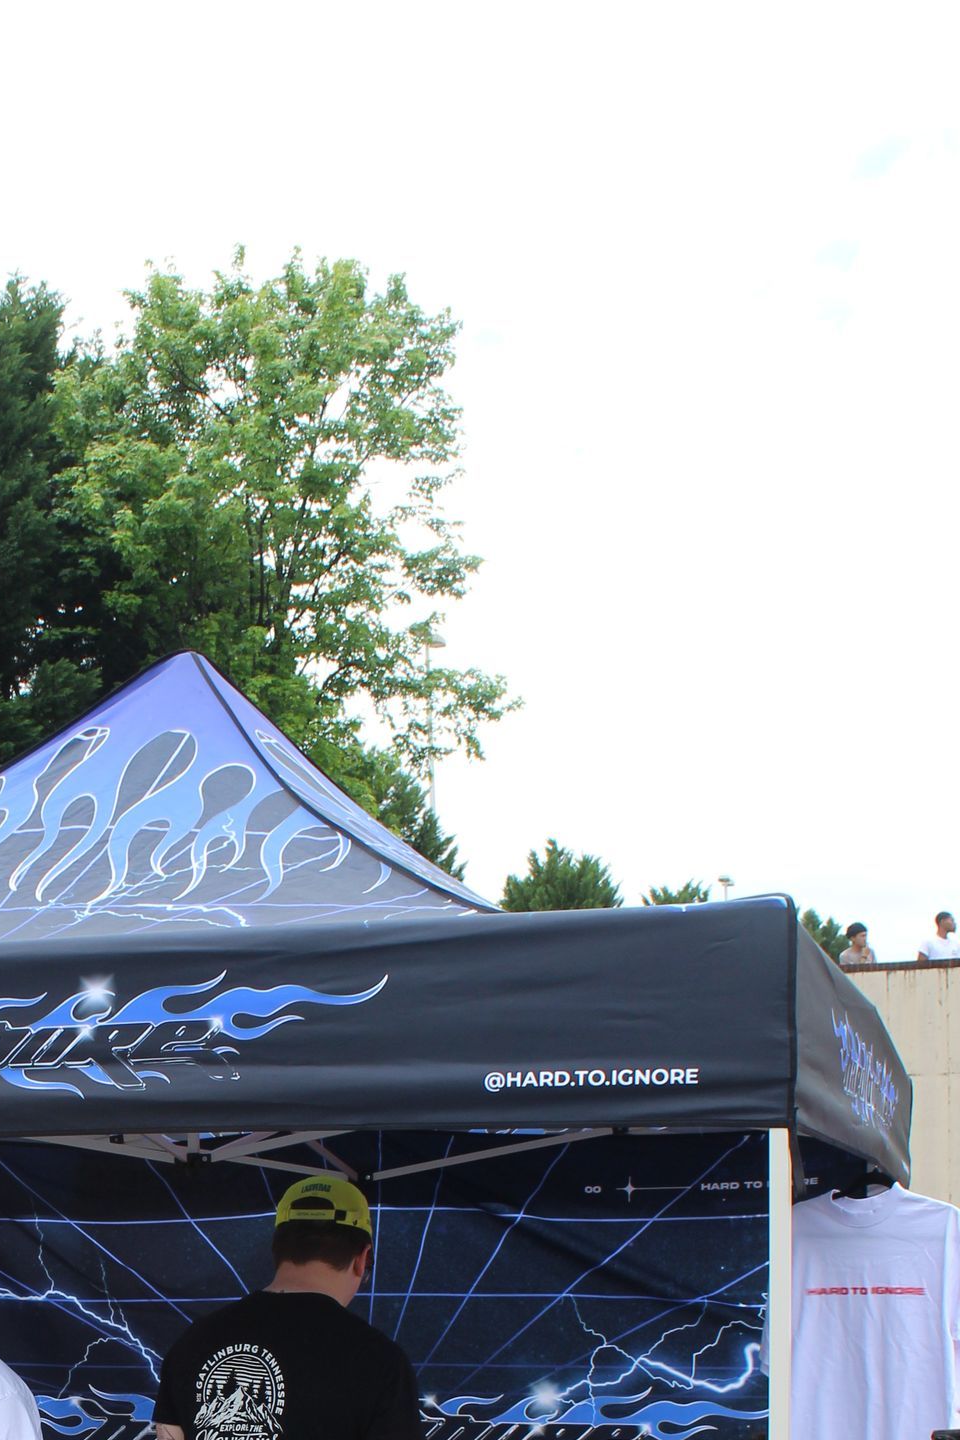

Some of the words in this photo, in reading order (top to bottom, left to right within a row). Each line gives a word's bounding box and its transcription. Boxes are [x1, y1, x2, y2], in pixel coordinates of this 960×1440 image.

[484, 1068, 700, 1093] @HARD.TO.IGNORE
[701, 1182, 740, 1191] HARD
[744, 1180, 763, 1189] TO
[806, 1286, 851, 1296] HARD
[853, 1286, 869, 1296] TO
[871, 1286, 925, 1296] IGNORE
[196, 1344, 259, 1390] GATLINBURG
[261, 1348, 286, 1416] TENNESSEE
[219, 1423, 249, 1433] EXPLORE
[249, 1424, 264, 1433] THE
